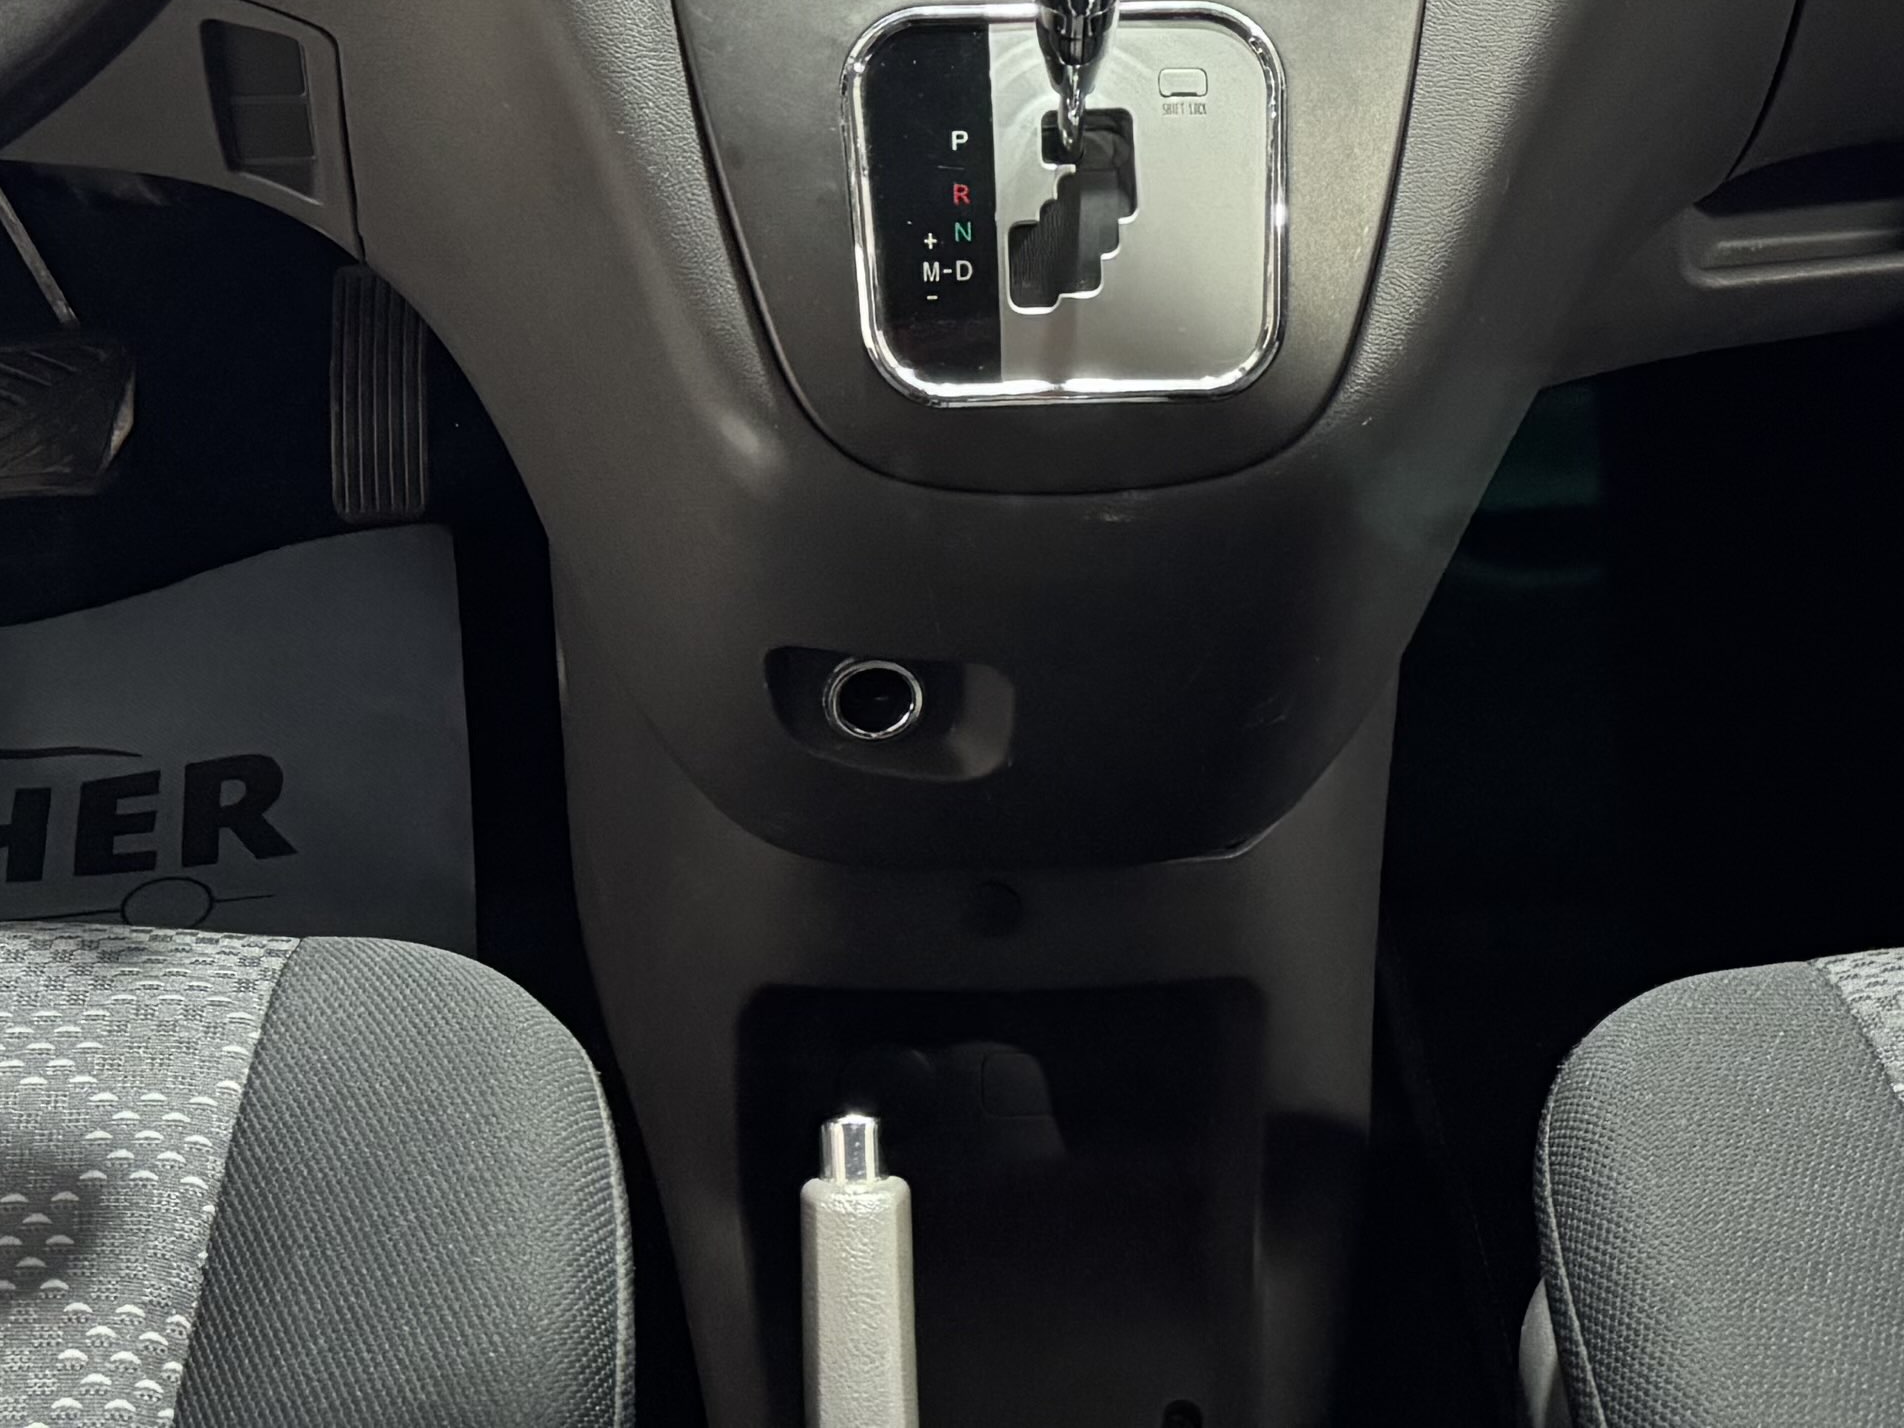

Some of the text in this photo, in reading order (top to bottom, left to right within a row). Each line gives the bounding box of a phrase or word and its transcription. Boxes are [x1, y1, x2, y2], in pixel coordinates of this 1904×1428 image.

[951, 130, 969, 152] P
[953, 183, 972, 206] R
[954, 221, 972, 243] N
